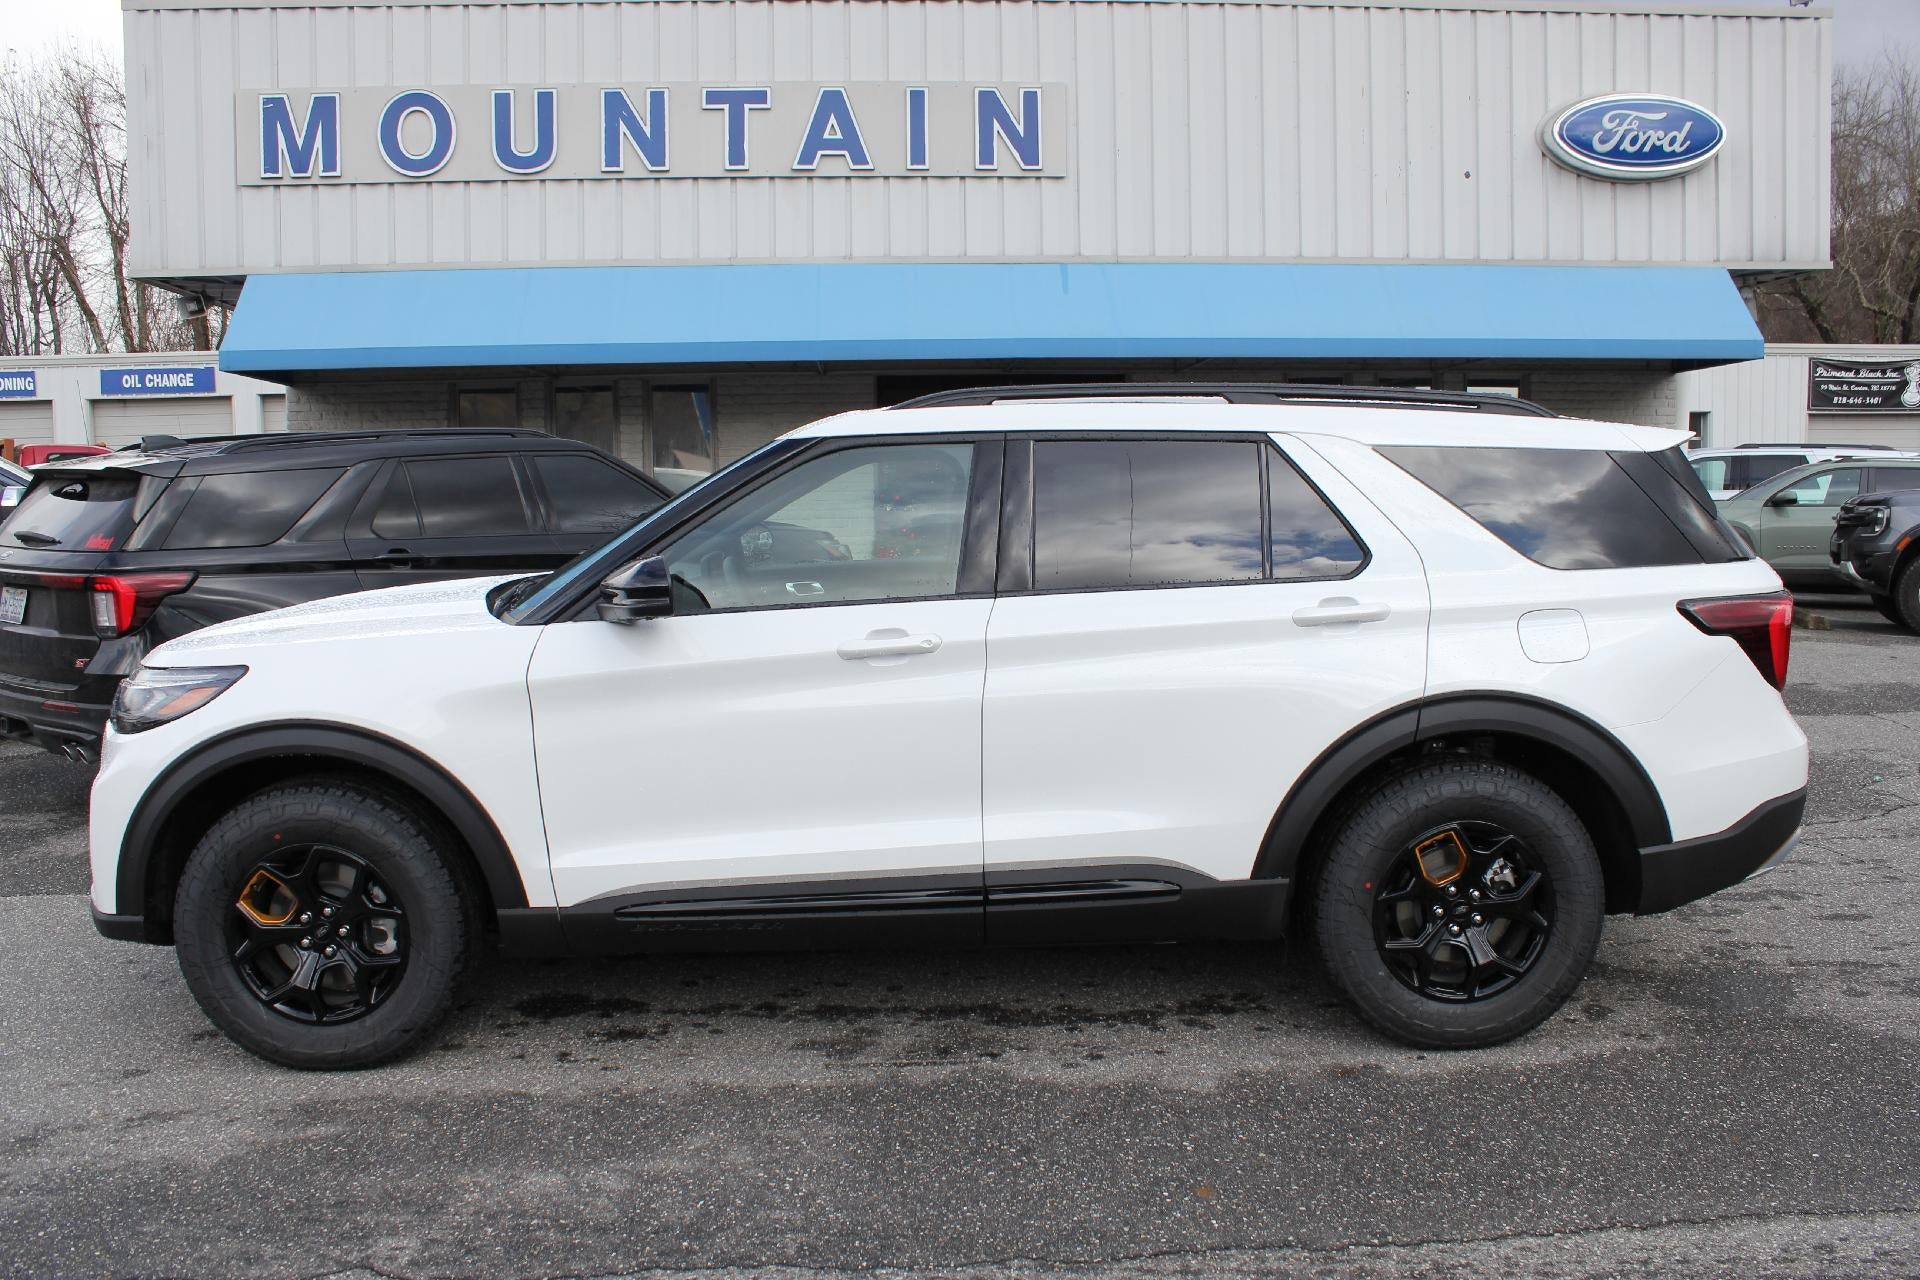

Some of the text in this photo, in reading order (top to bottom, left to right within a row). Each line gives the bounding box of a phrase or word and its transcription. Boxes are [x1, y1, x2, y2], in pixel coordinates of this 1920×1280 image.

[259, 86, 1042, 178] MOUNTAIN
[1592, 109, 1692, 153] Ford
[122, 373, 194, 388] OIL CHANGE
[1857, 368, 1883, 378] Black
